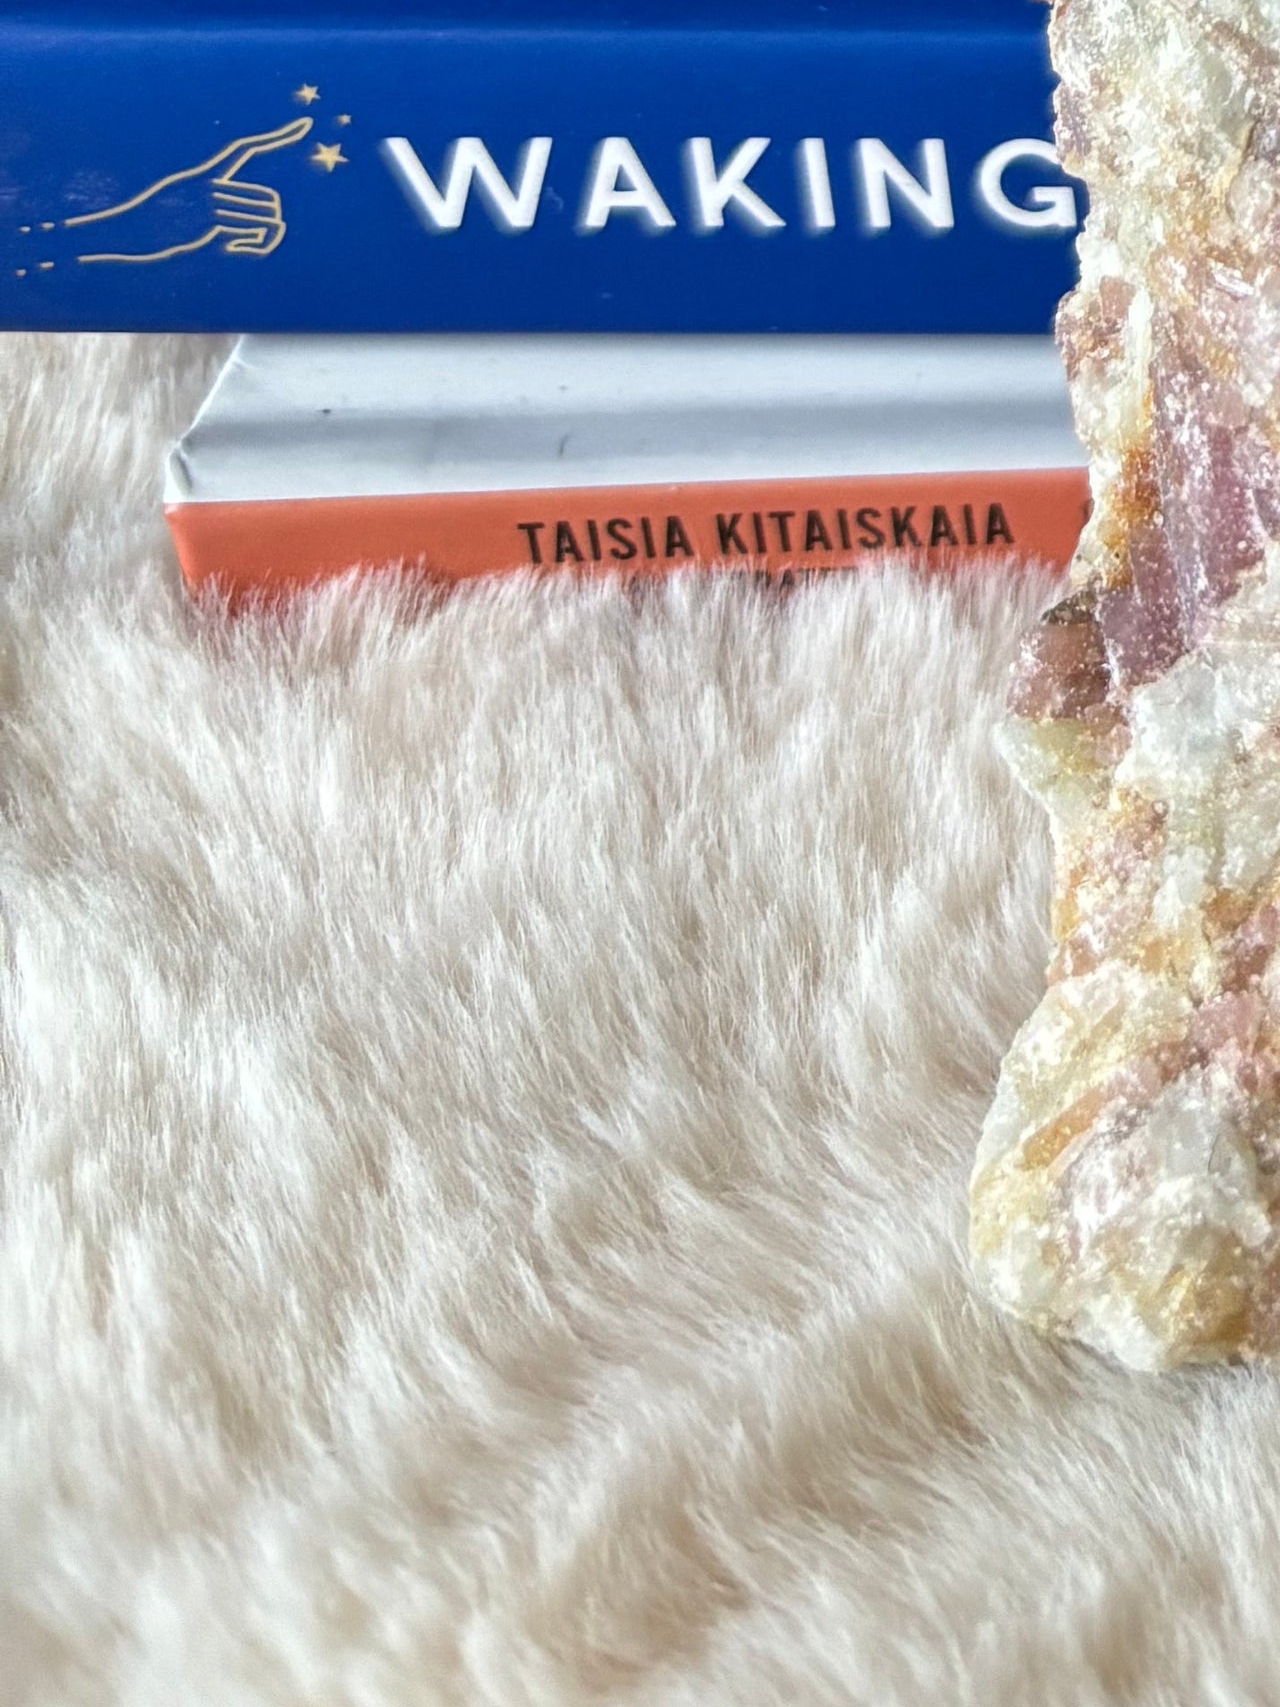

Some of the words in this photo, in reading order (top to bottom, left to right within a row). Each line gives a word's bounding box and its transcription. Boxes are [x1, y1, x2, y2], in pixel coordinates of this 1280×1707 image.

[382, 135, 1079, 230] WAKING
[517, 514, 695, 565] TAISIA
[714, 501, 1015, 556] KITAISKAIA
